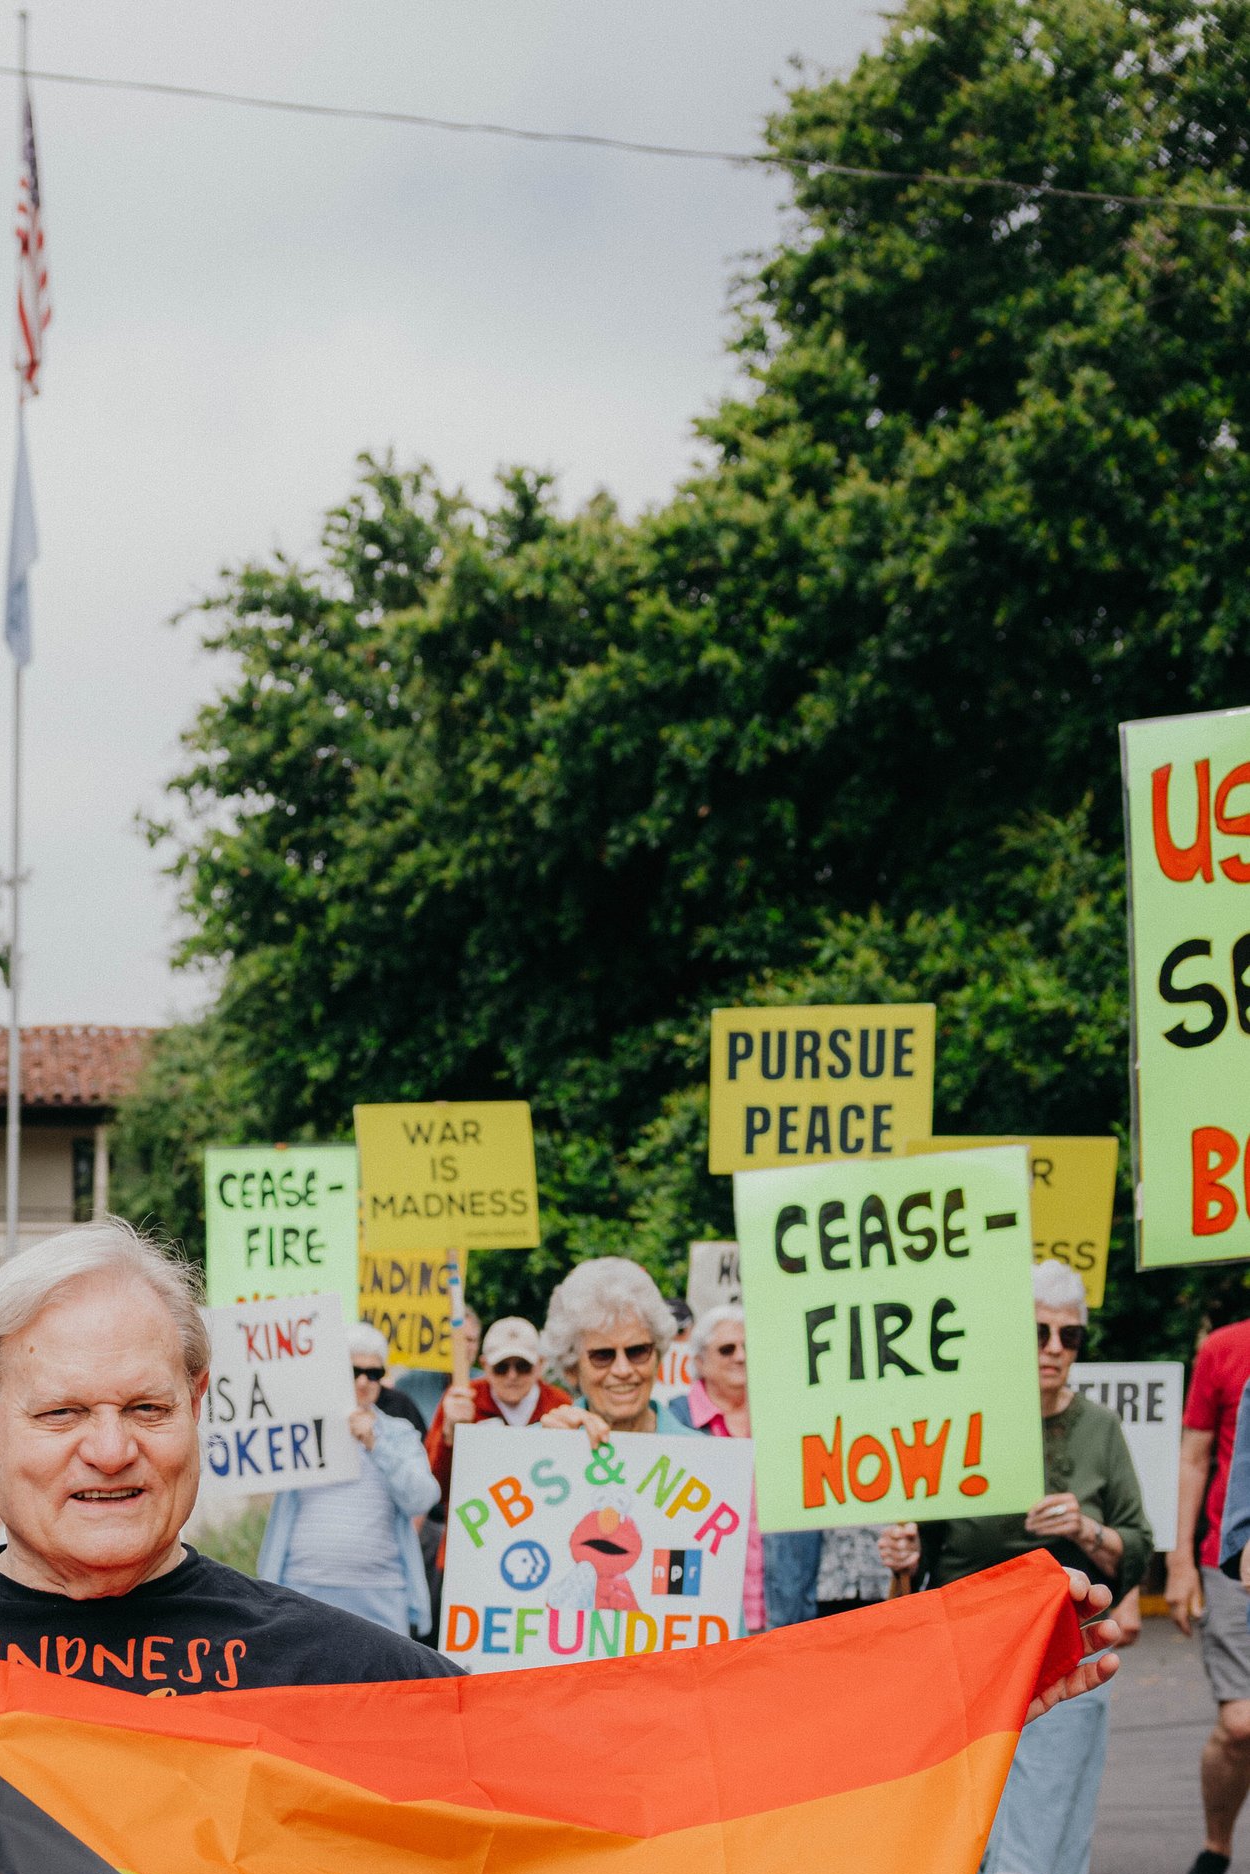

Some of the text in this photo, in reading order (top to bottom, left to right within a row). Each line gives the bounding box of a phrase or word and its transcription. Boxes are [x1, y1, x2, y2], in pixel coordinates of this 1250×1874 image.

[727, 1028, 914, 1081] PURSUE
[403, 1119, 481, 1145] WAR
[744, 1104, 893, 1156] PEACE
[430, 1155, 459, 1182] IS
[371, 1188, 529, 1219] MADNESS
[247, 1227, 326, 1267] FIRE
[805, 1297, 966, 1386] FIRE
[250, 1373, 273, 1419] A
[207, 1418, 326, 1478] OKER!
[801, 1411, 990, 1508] NOW!
[455, 1442, 741, 1556] PBS & NPR
[653, 1564, 698, 1582] npr
[445, 1604, 731, 1658] DEFUNDED
